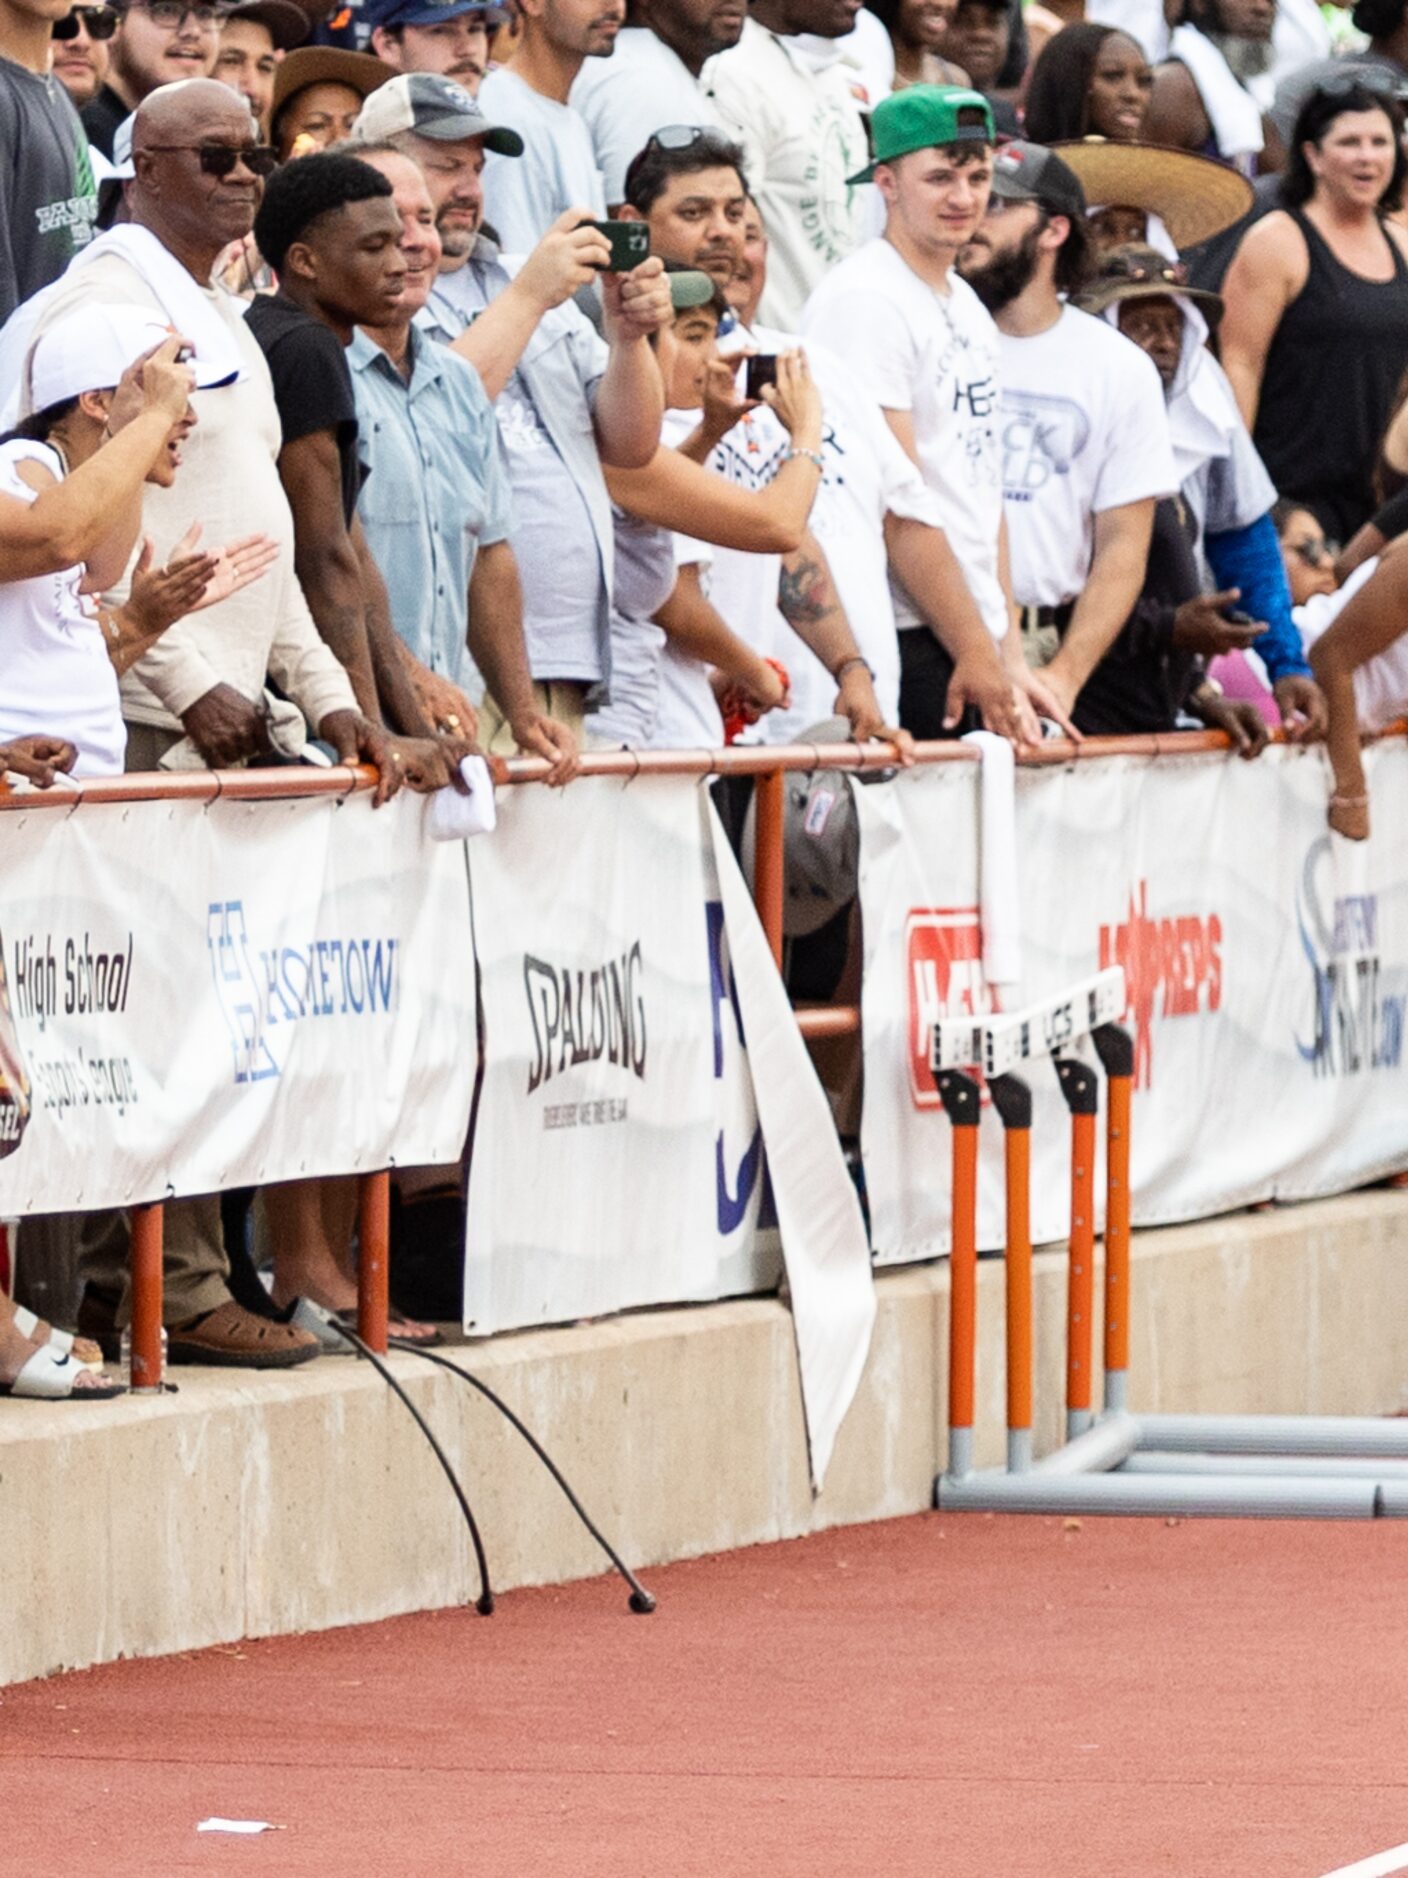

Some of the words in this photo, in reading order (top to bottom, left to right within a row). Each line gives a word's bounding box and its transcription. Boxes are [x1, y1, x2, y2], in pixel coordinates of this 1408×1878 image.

[15, 933, 56, 1032] High
[64, 931, 133, 1015] School
[523, 938, 647, 1095] SPALDING
